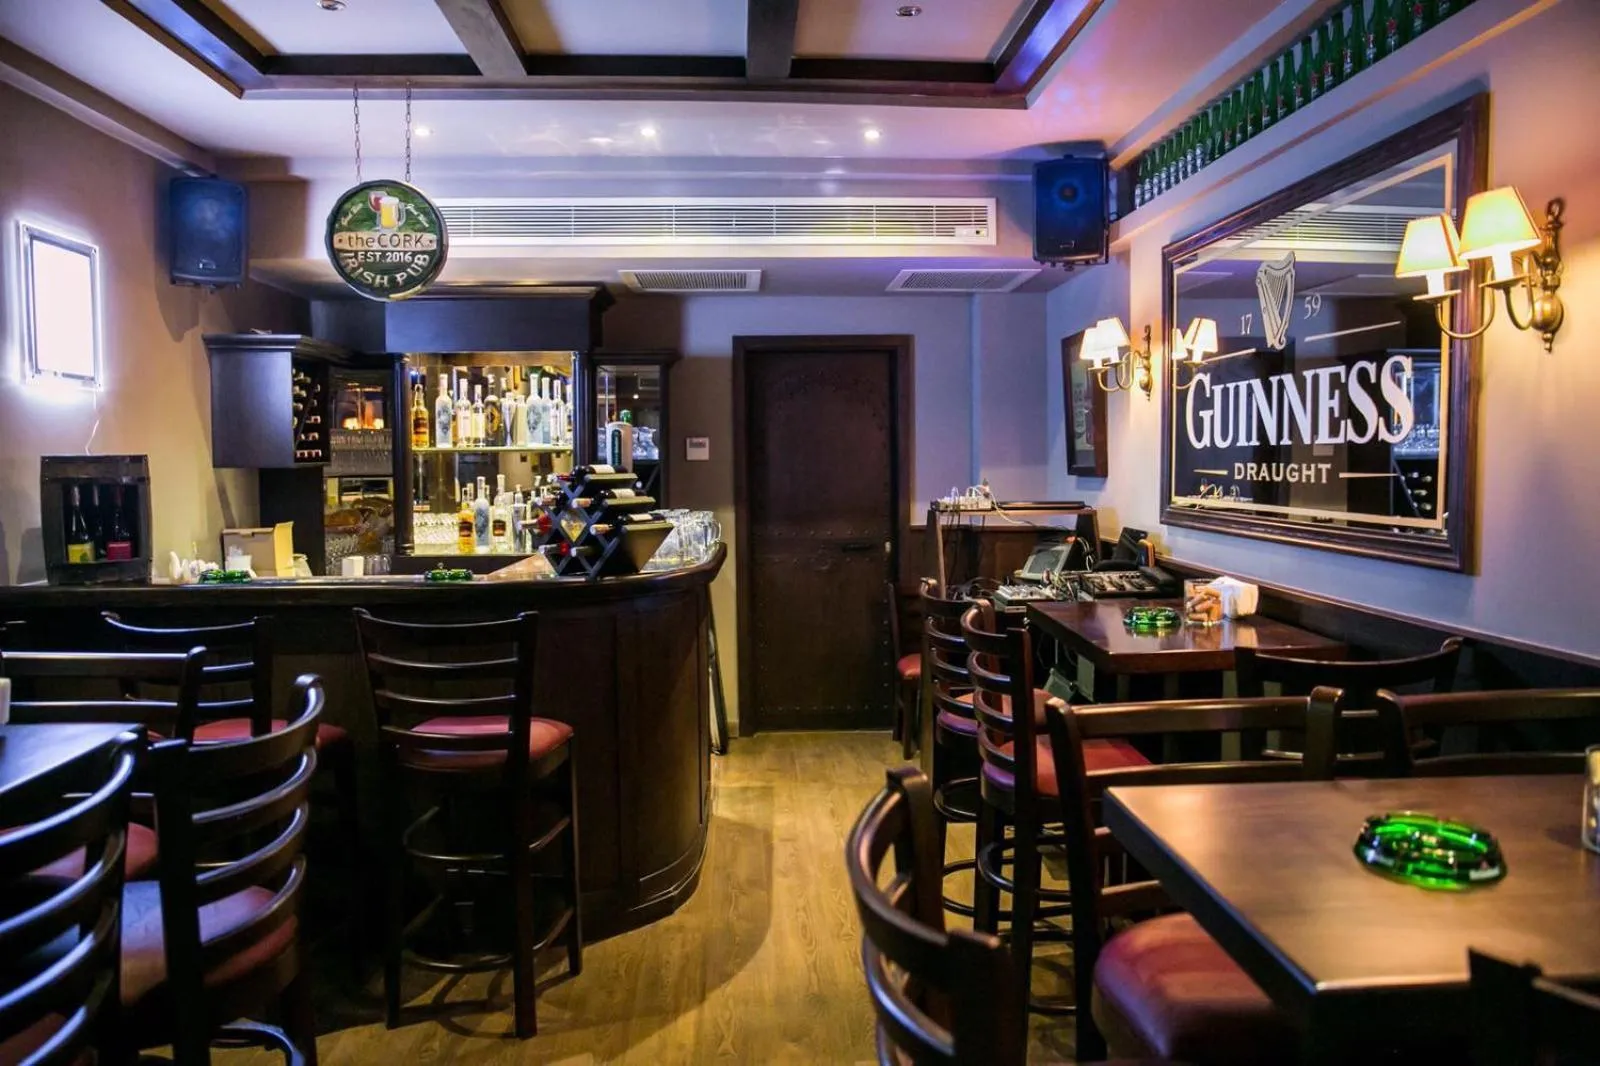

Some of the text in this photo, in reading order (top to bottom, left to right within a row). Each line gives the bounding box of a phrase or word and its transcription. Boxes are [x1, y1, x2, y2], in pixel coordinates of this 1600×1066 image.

[343, 252, 430, 288] IRISH PUB
[386, 251, 413, 263] 2016
[1240, 292, 1322, 335] 17 59
[1185, 354, 1415, 450] GUINNESS
[1233, 462, 1332, 484] DRAUGHT
